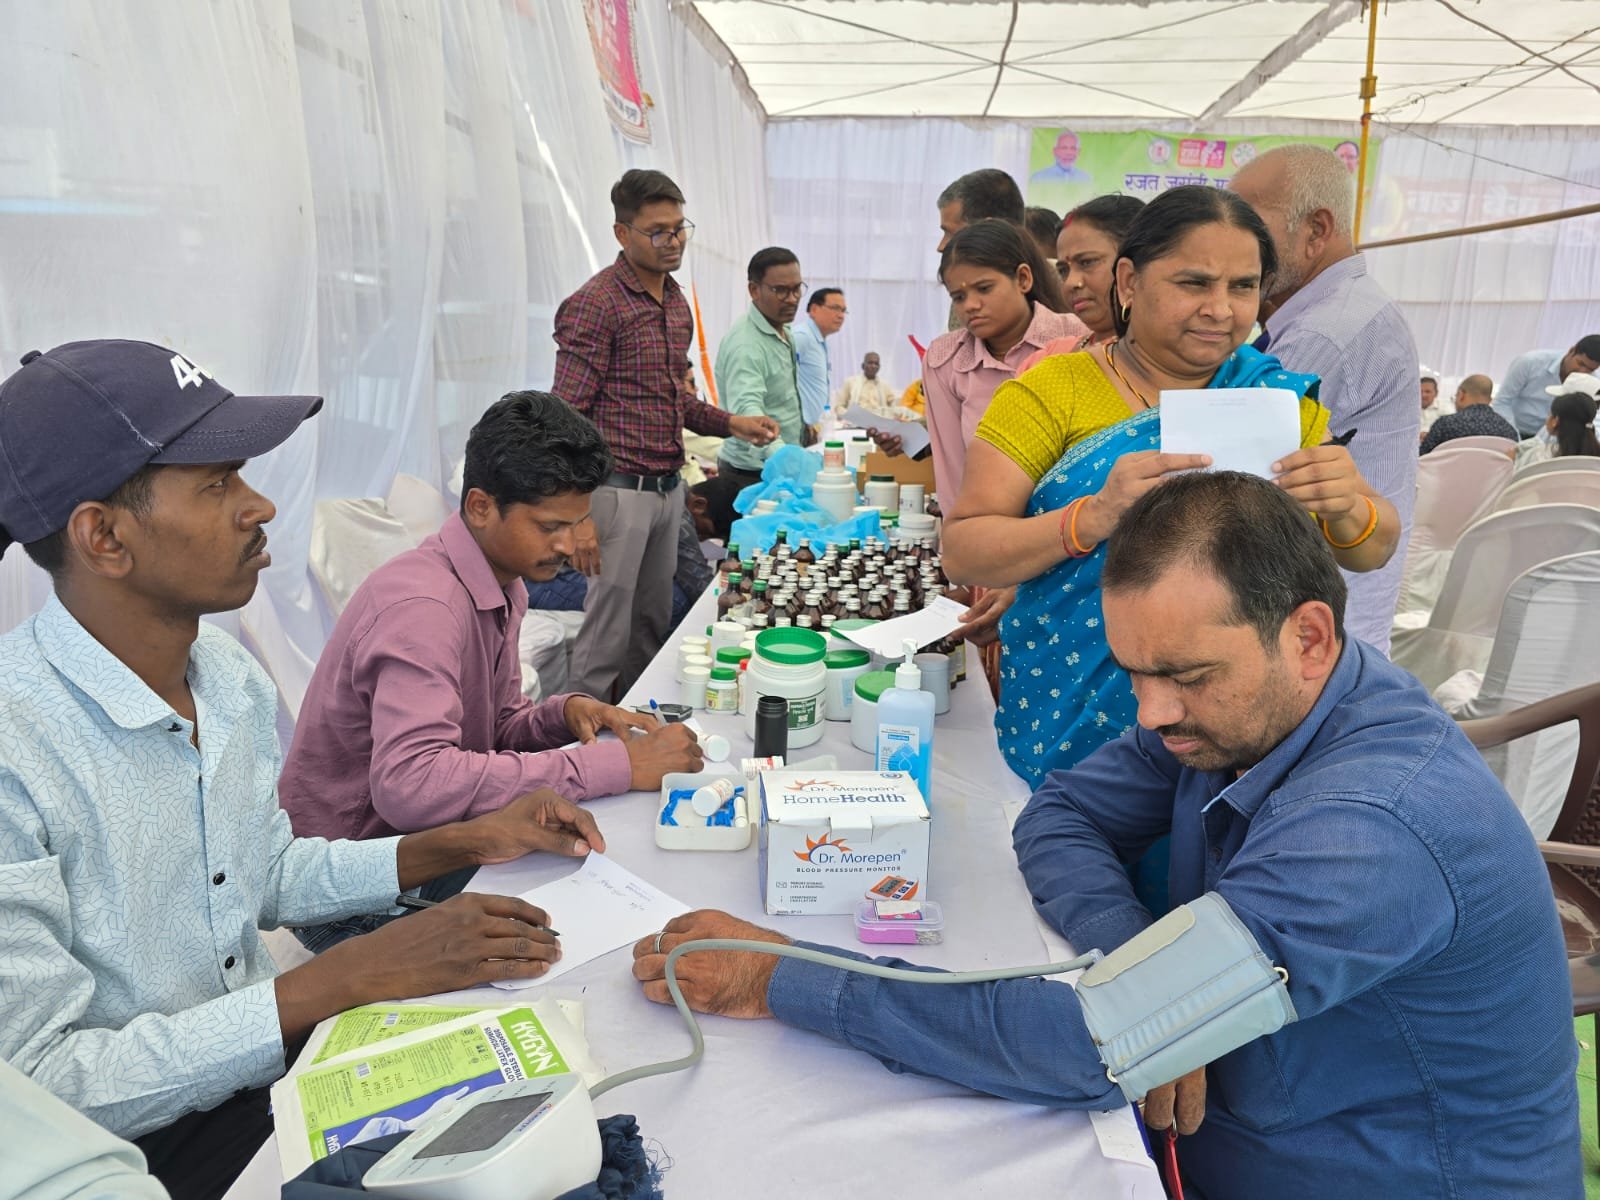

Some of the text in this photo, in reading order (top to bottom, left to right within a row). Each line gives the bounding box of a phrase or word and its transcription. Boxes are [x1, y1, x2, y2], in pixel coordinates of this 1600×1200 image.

[1125, 174, 1160, 190] रजत
[810, 784, 896, 794] Dr. Morepen
[783, 793, 906, 805] HomeHealth
[818, 852, 901, 865] Dr. Morepen
[510, 1020, 560, 1074] HYGYN
